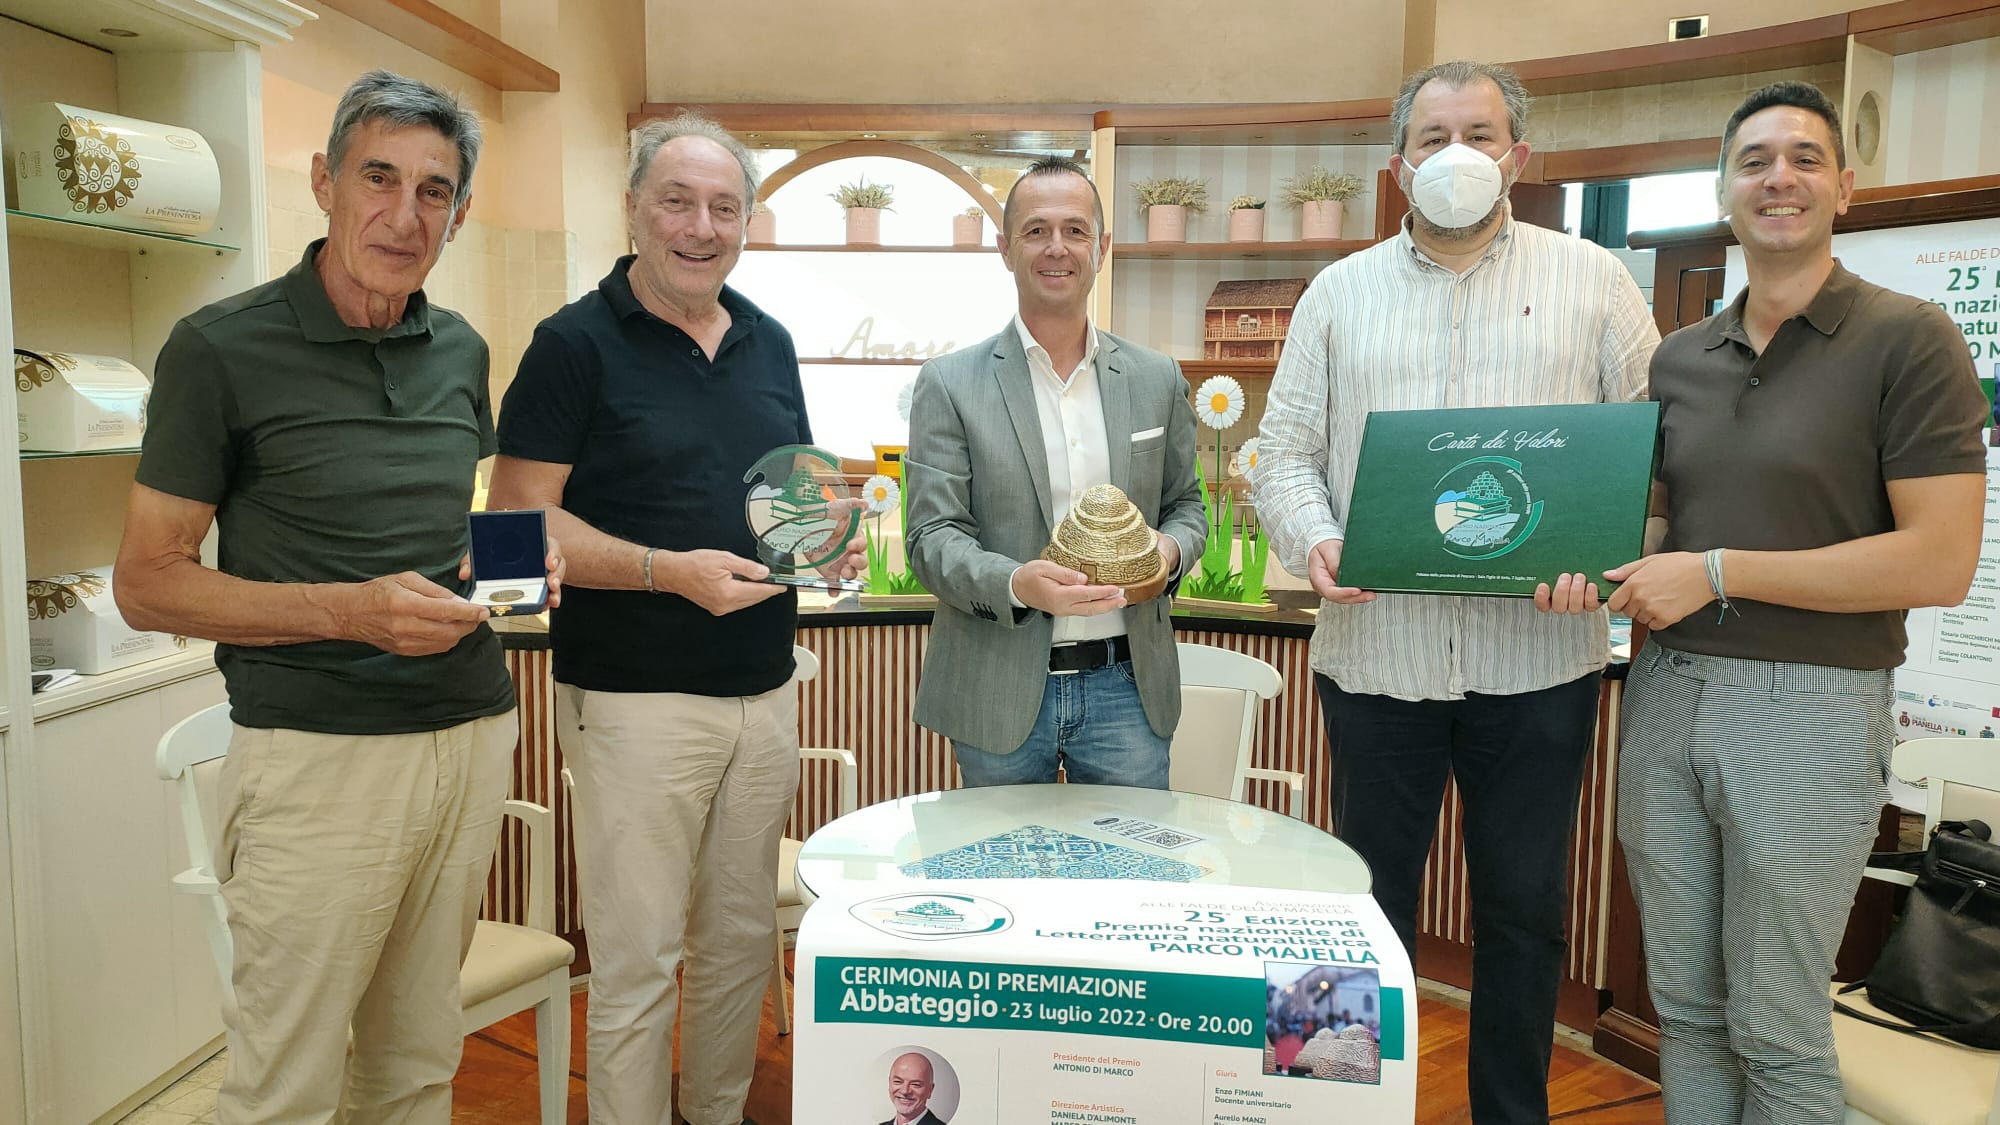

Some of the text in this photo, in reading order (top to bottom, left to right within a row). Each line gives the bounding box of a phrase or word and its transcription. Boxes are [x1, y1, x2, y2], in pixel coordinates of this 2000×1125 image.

[1916, 247, 2000, 264] ALLE FALDE D
[1954, 294, 2000, 314] nazi
[830, 316, 956, 358] Amore
[1428, 428, 1569, 452] Carta dei Valori
[1912, 719, 1942, 732] PIANELLA
[1244, 915, 1360, 928] Edizione
[1094, 921, 1366, 938] Premio nazionale di
[1034, 928, 1372, 948] Letteratura naturalistica
[1149, 942, 1381, 965] PARCO MAJELLA
[840, 965, 1148, 1000] CERIMONIA DI PREMIAZIONE
[840, 988, 1253, 1037] Abbateggio 23 luglio 2022 Ore 20.00
[1053, 1052, 1141, 1067] Presidente del Premio
[1053, 1063, 1134, 1077] ANTONIO DI MARCO
[1215, 1069, 1238, 1079] Giuria
[1215, 1087, 1264, 1098] Enzo FIMIANI
[1051, 1100, 1125, 1114] Direzione Artistica
[1214, 1096, 1292, 1110] Docente universitario
[1051, 1110, 1137, 1125] DANIELA D'ALIMONTE
[1214, 1113, 1267, 1125] Aurelio MANZI
